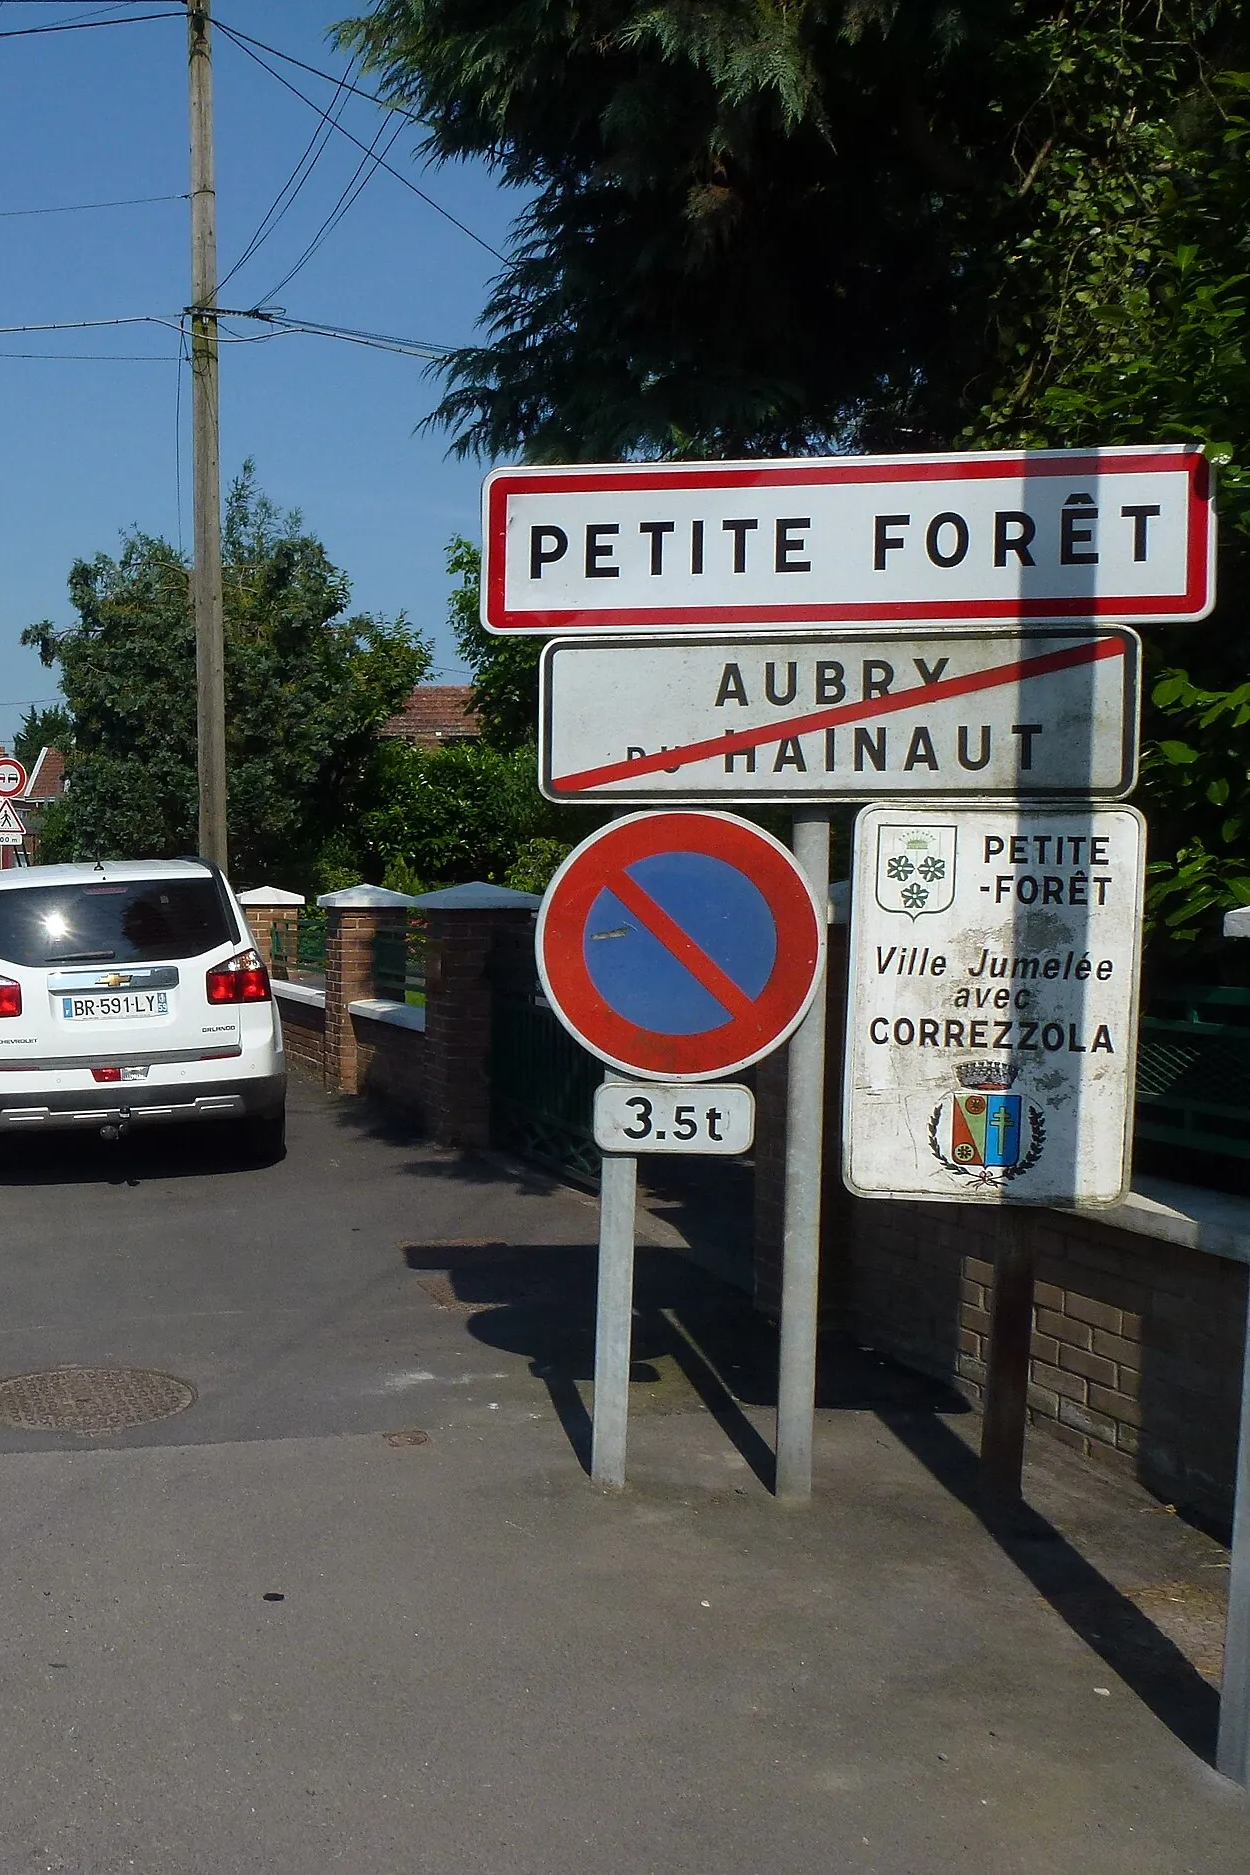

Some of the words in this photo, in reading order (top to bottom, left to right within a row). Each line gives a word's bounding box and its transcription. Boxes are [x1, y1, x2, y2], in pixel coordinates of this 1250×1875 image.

[529, 517, 812, 580] PETITE
[873, 492, 1161, 571] FORÊT
[715, 657, 950, 707] AUBRY
[724, 724, 1043, 773] HAINAUT
[984, 836, 1111, 866] PETITE
[979, 871, 1113, 907] -FORÊT
[876, 946, 947, 976] Ville
[967, 948, 1114, 982] Jumelée
[73, 995, 155, 1016] BR-591-LY
[954, 987, 1031, 1010] avec
[202, 1025, 236, 1033] ORLANDO
[870, 1017, 1114, 1055] CORREZZOLA
[623, 1096, 723, 1142] 3.5t
